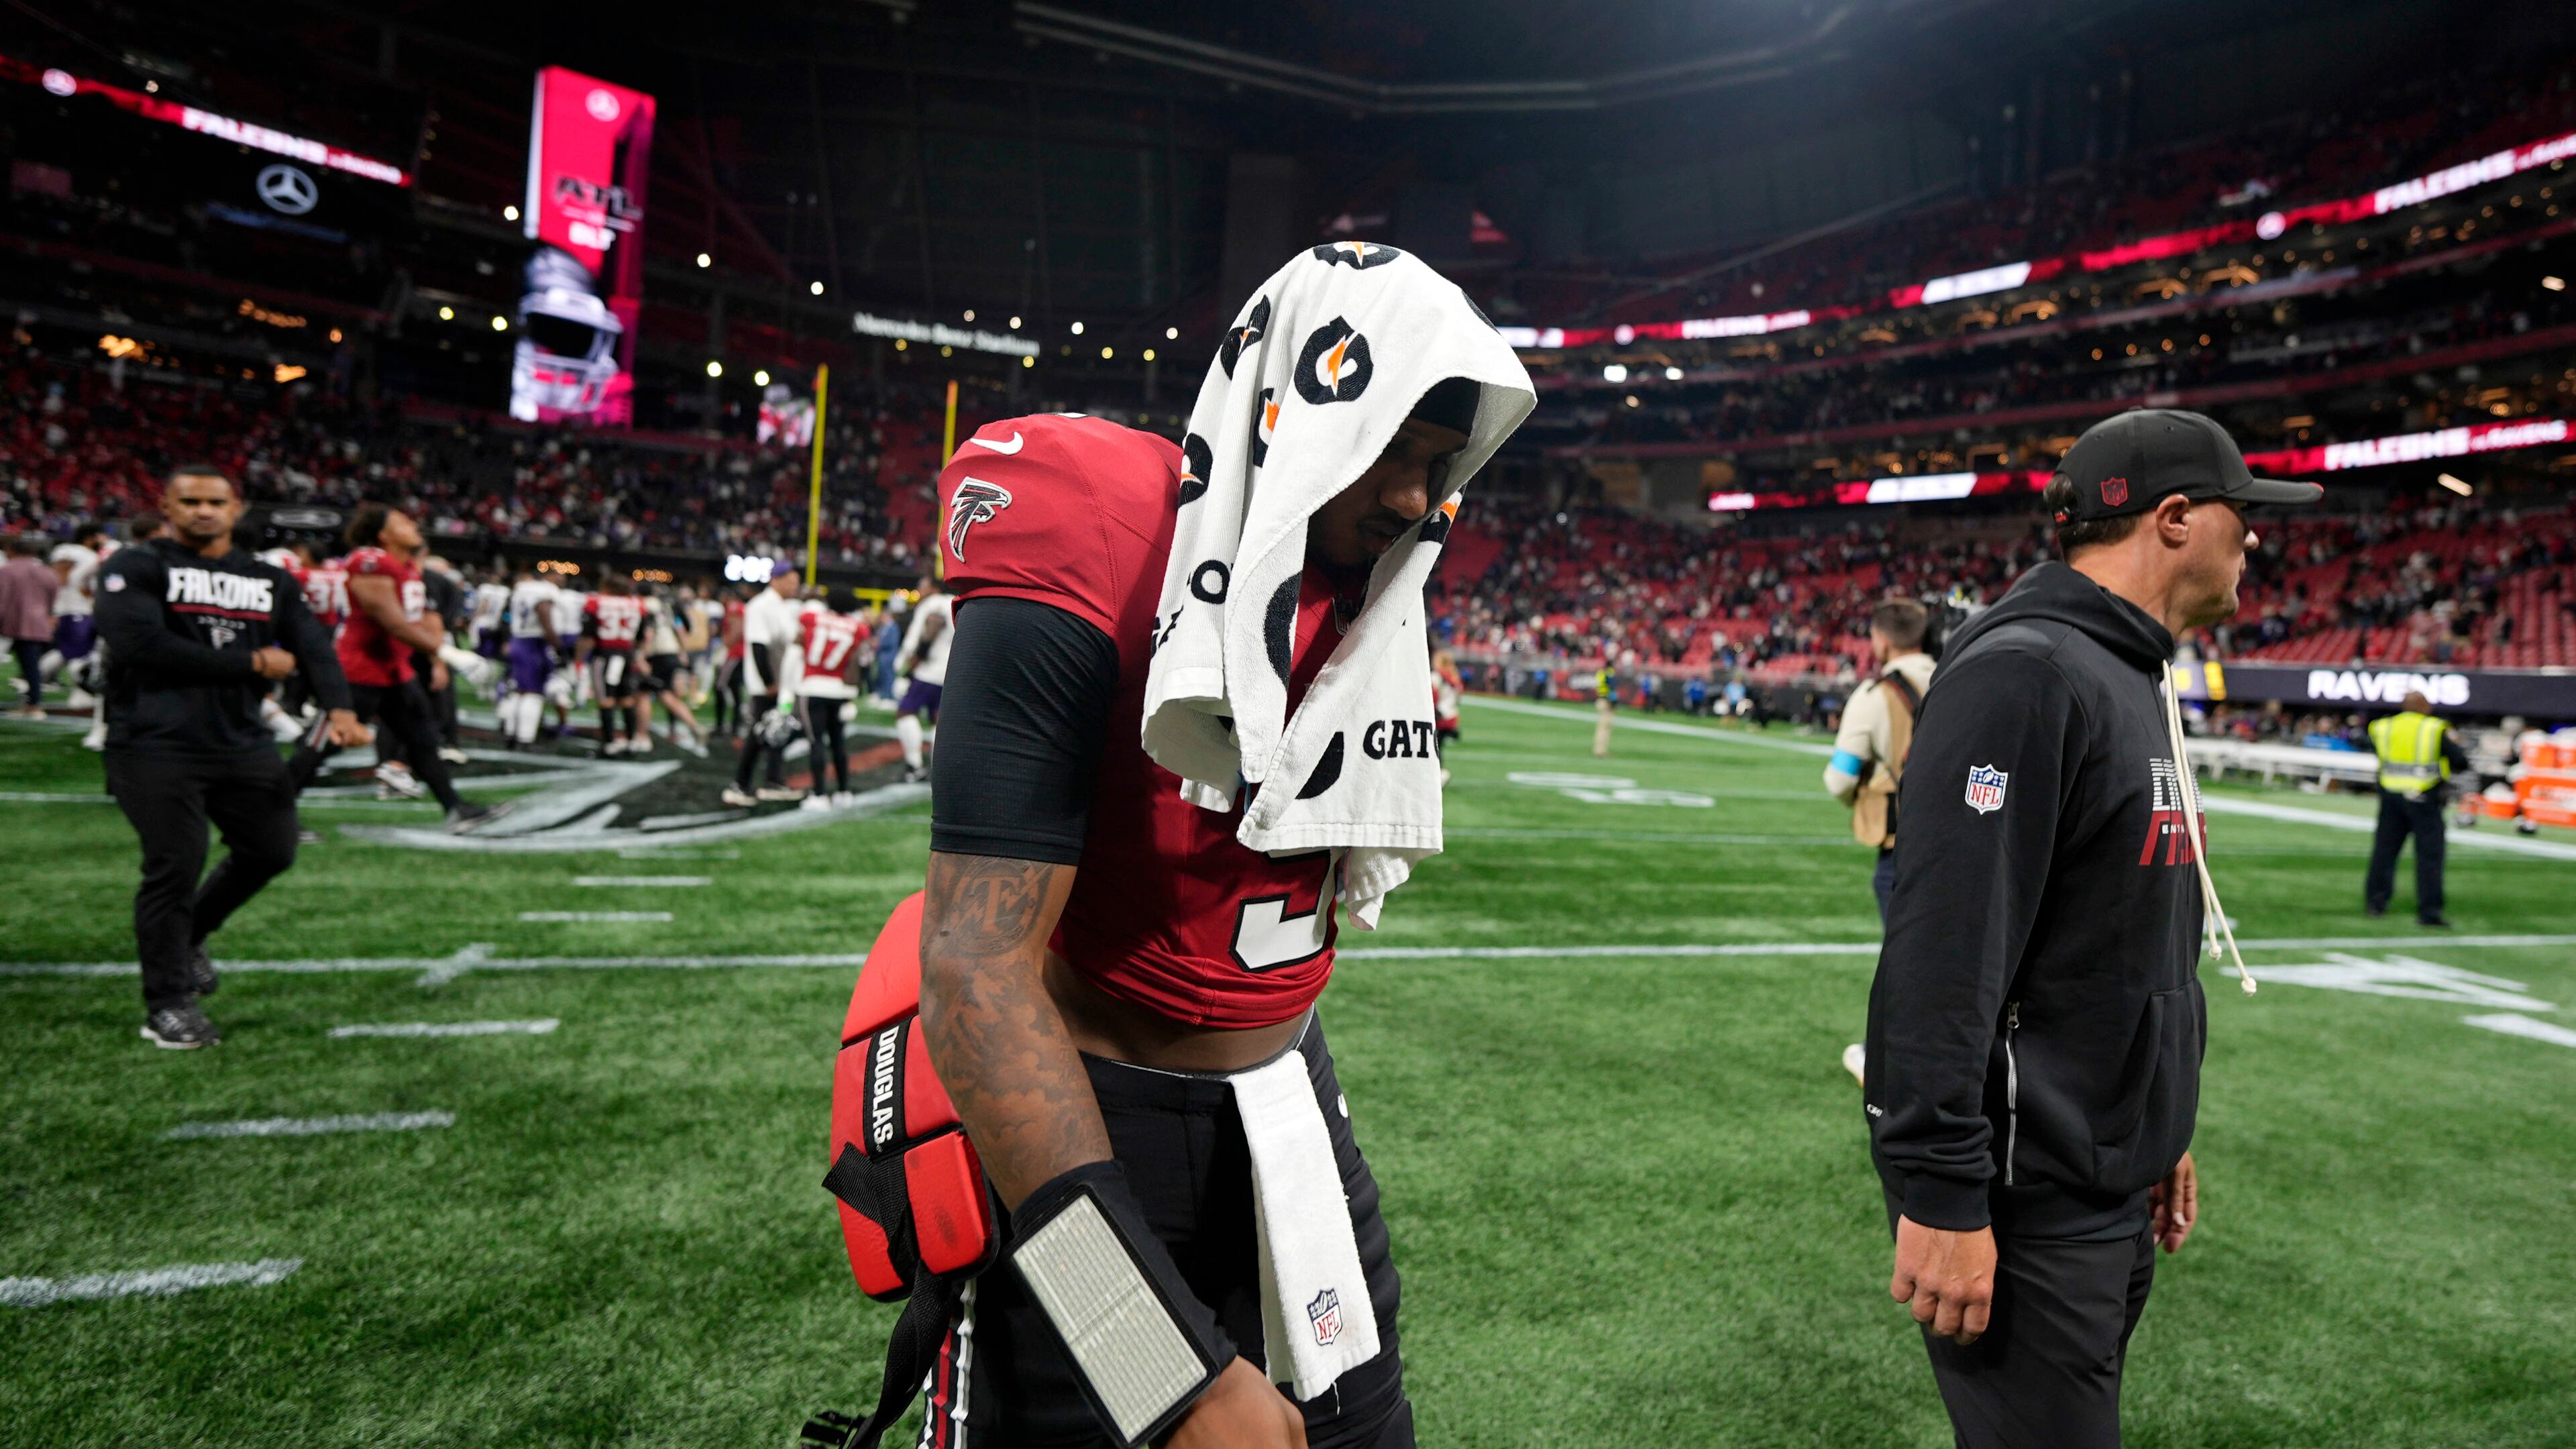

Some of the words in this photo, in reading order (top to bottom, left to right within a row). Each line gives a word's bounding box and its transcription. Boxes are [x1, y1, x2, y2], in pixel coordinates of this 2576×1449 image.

[2324, 427, 2469, 471] FALCONS
[167, 567, 273, 612] FALCONS
[596, 609, 641, 641] 33
[808, 627, 854, 670] 17
[2308, 670, 2471, 705] RAVENS
[1362, 720, 1439, 759] GAT
[1970, 783, 1999, 806] NFL
[872, 1026, 899, 1148] DOUGLAS
[1317, 1310, 1340, 1340] NFL
